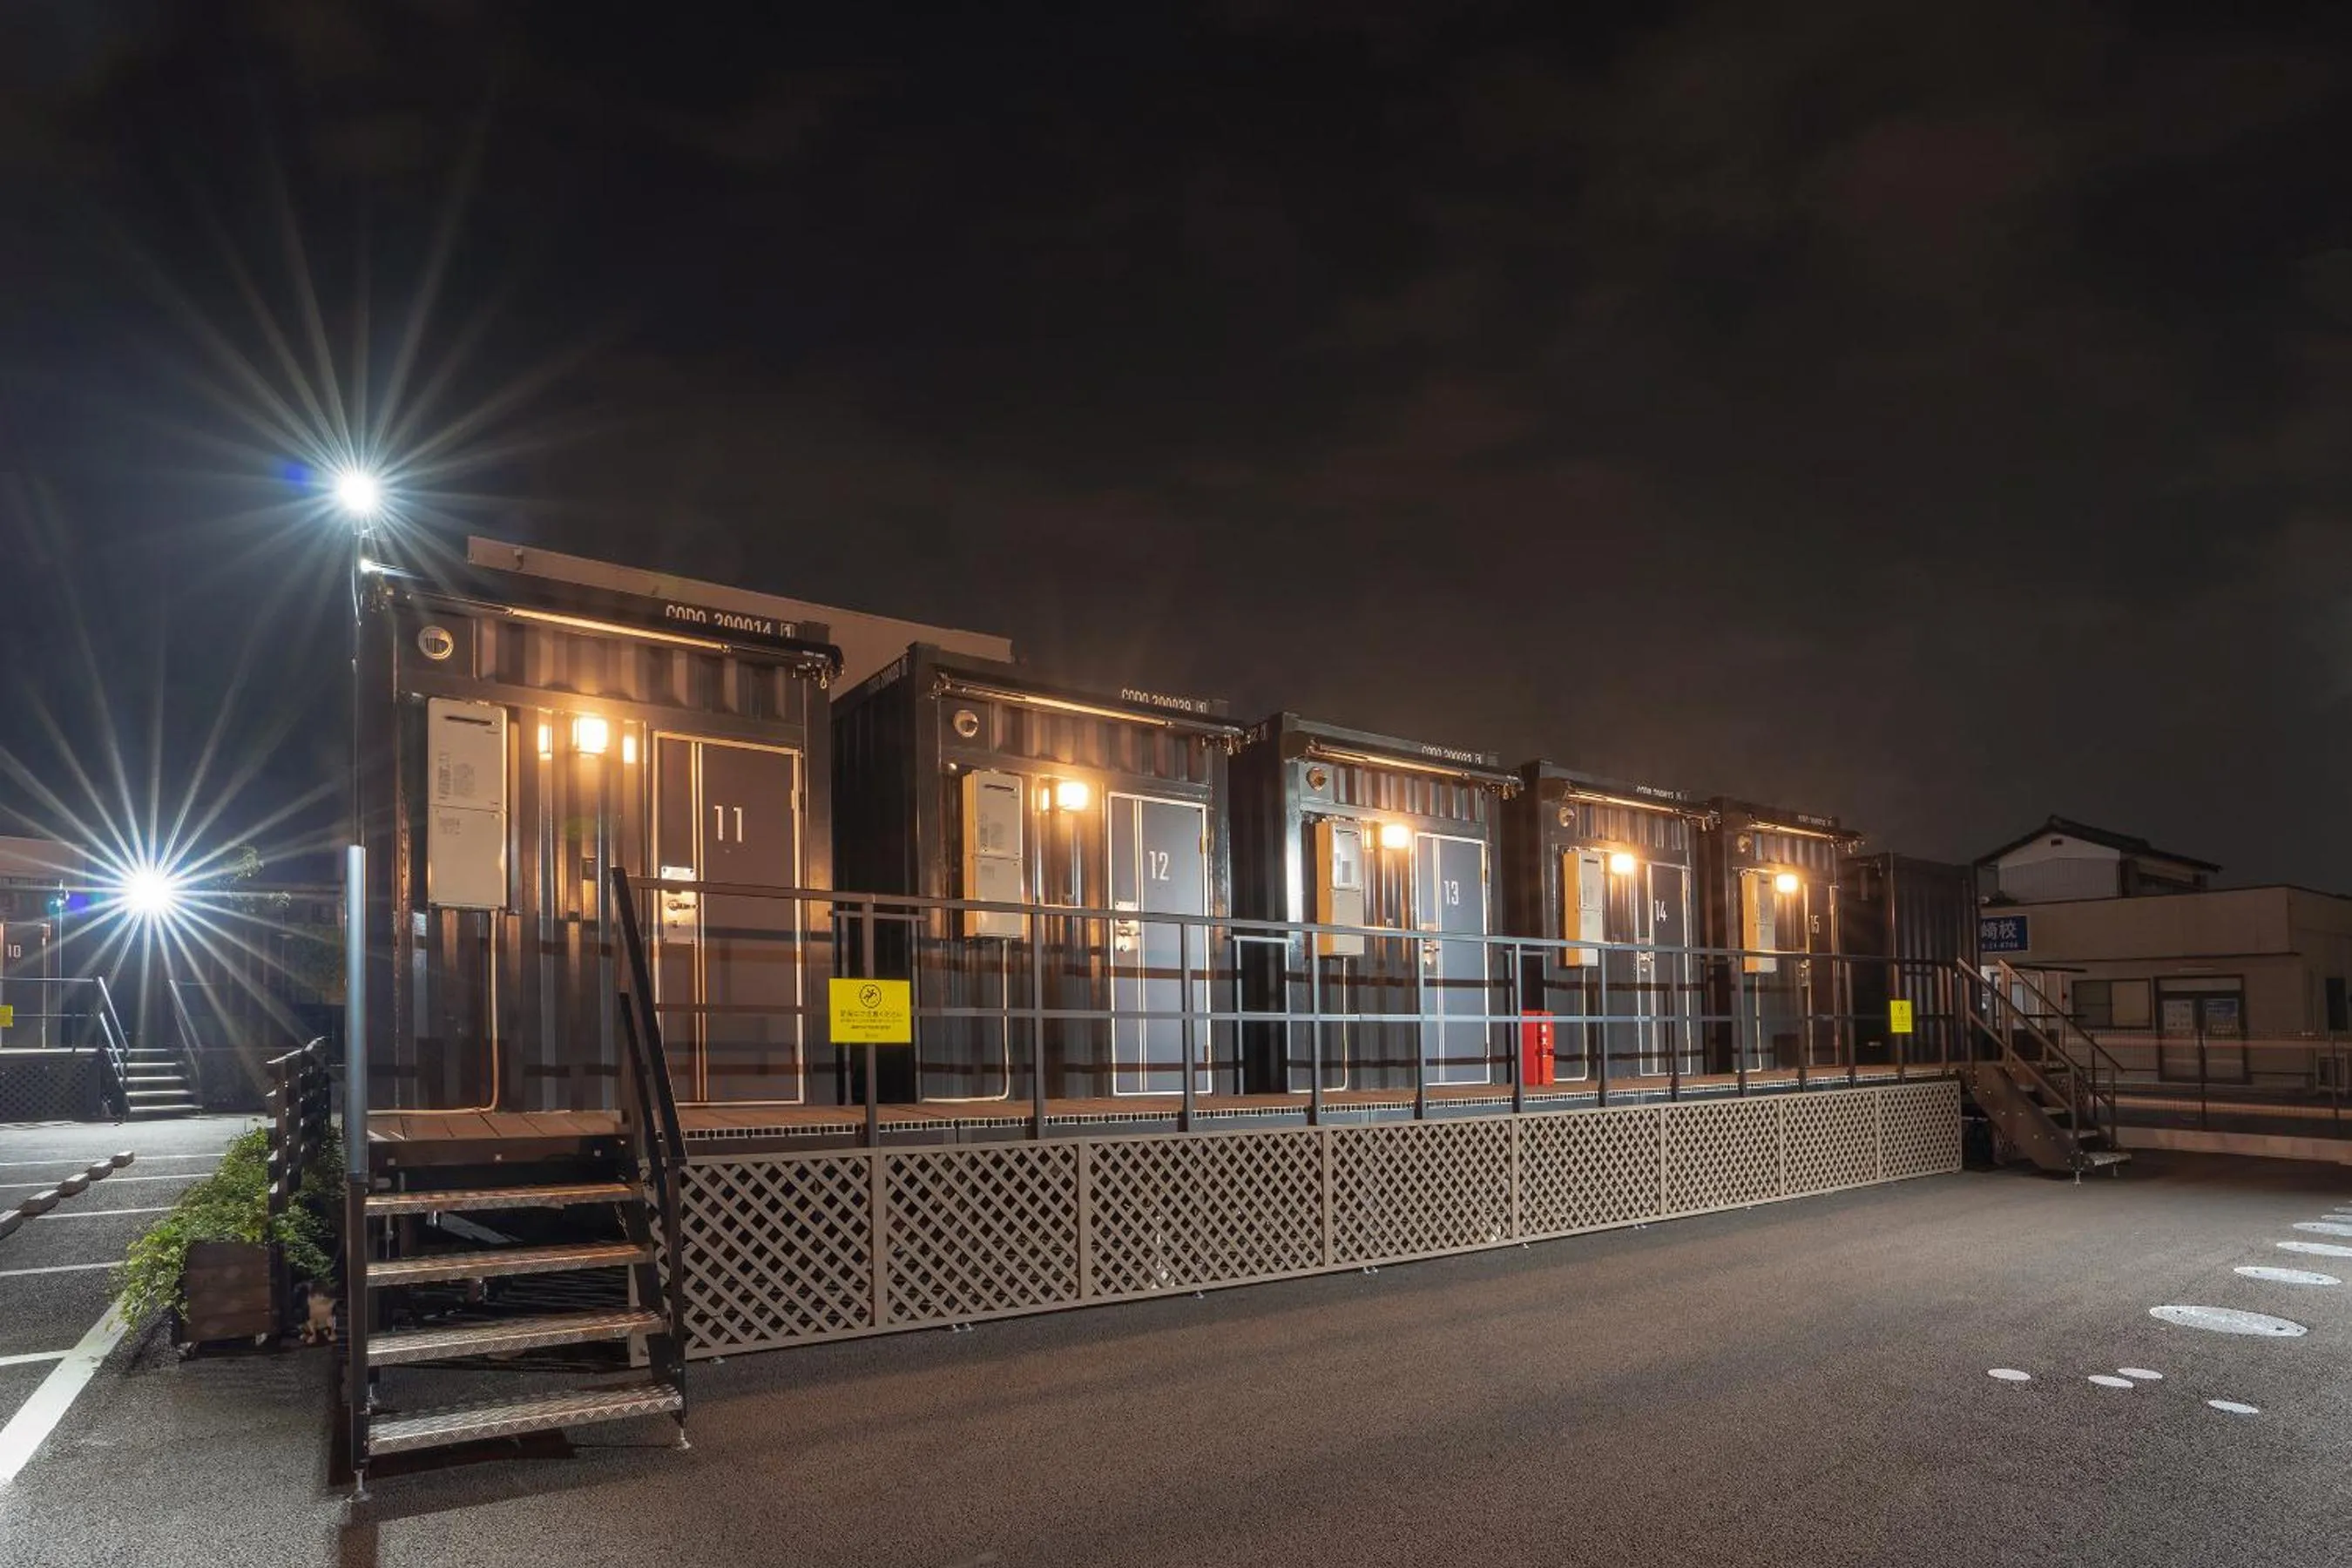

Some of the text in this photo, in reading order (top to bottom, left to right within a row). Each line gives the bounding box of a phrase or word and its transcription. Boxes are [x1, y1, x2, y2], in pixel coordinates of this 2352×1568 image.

[714, 805, 743, 843] 11
[1148, 850, 1170, 882] 12
[1443, 881, 1460, 907] 13
[1654, 900, 1668, 922] 14
[1810, 915, 1820, 934] 15
[7, 943, 22, 958] 10
